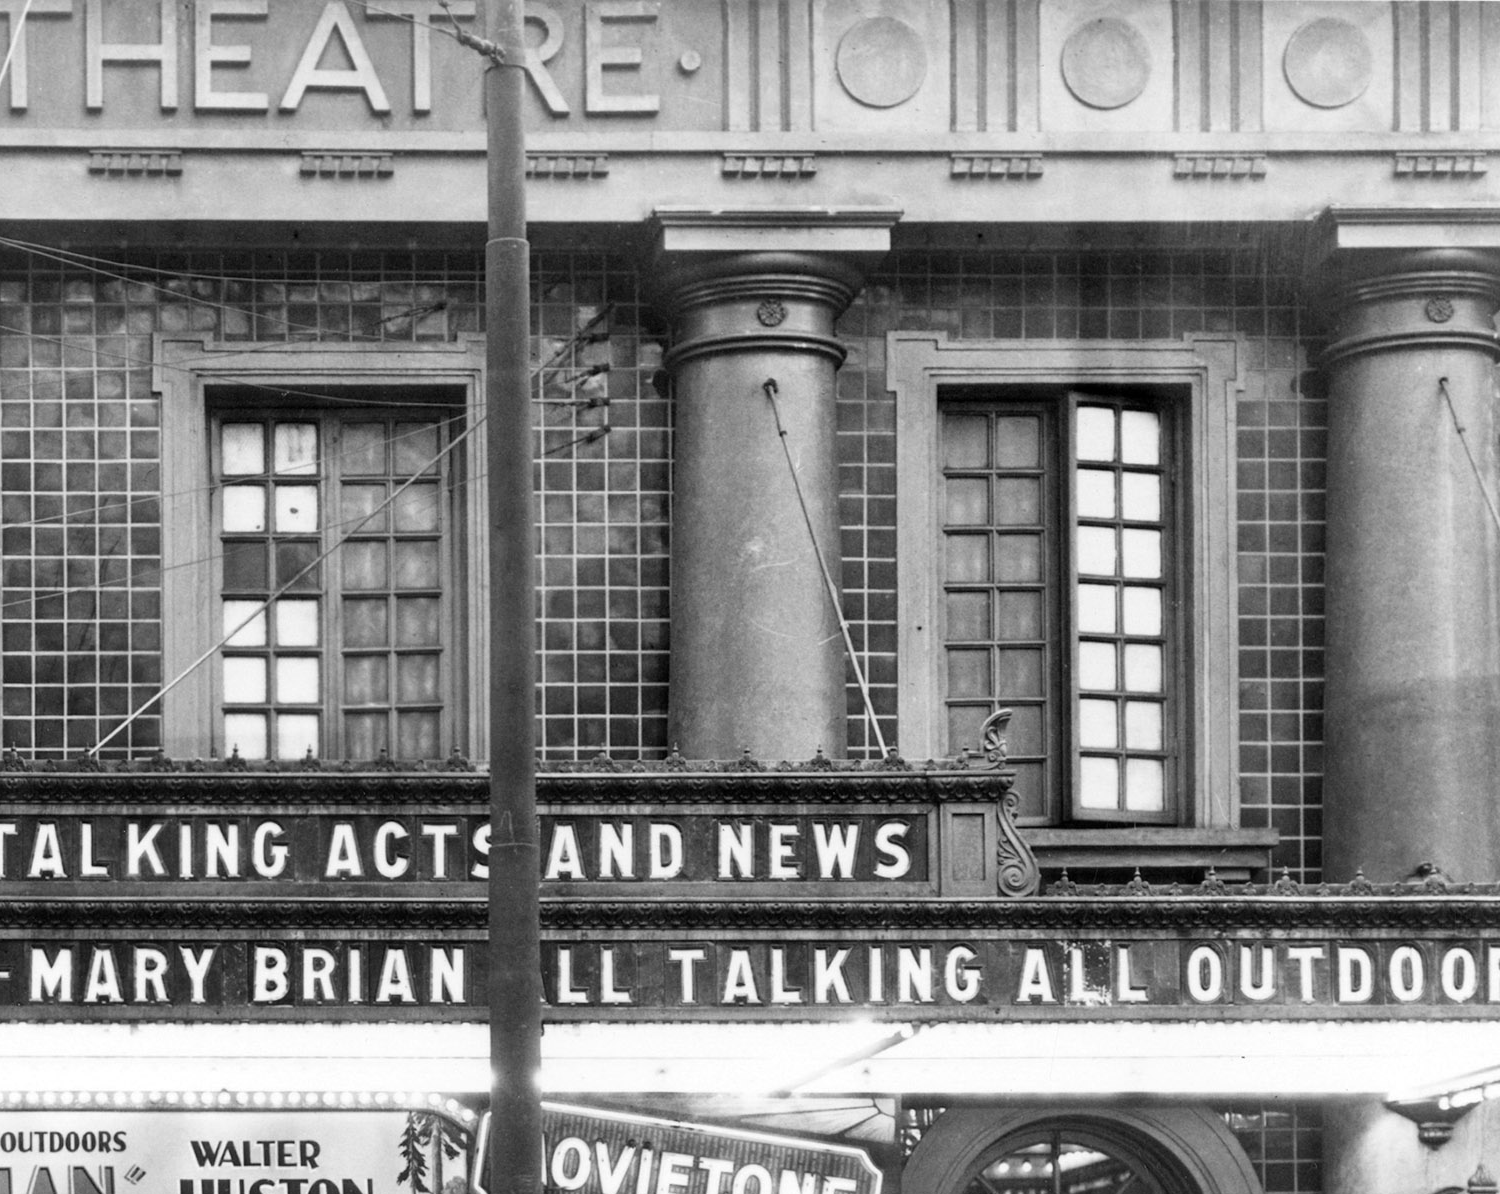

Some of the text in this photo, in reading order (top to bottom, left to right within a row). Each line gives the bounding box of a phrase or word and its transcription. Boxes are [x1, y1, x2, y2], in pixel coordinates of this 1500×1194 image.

[544, 823, 683, 880] AND
[717, 823, 912, 880] NEWS
[252, 946, 468, 1003] BRIAN
[540, 948, 633, 1004] LL
[668, 947, 982, 1004] TALKING
[1014, 944, 1150, 1004] ALL
[0, 1131, 128, 1154] OUTDOORS
[190, 1140, 322, 1169] WALTER
